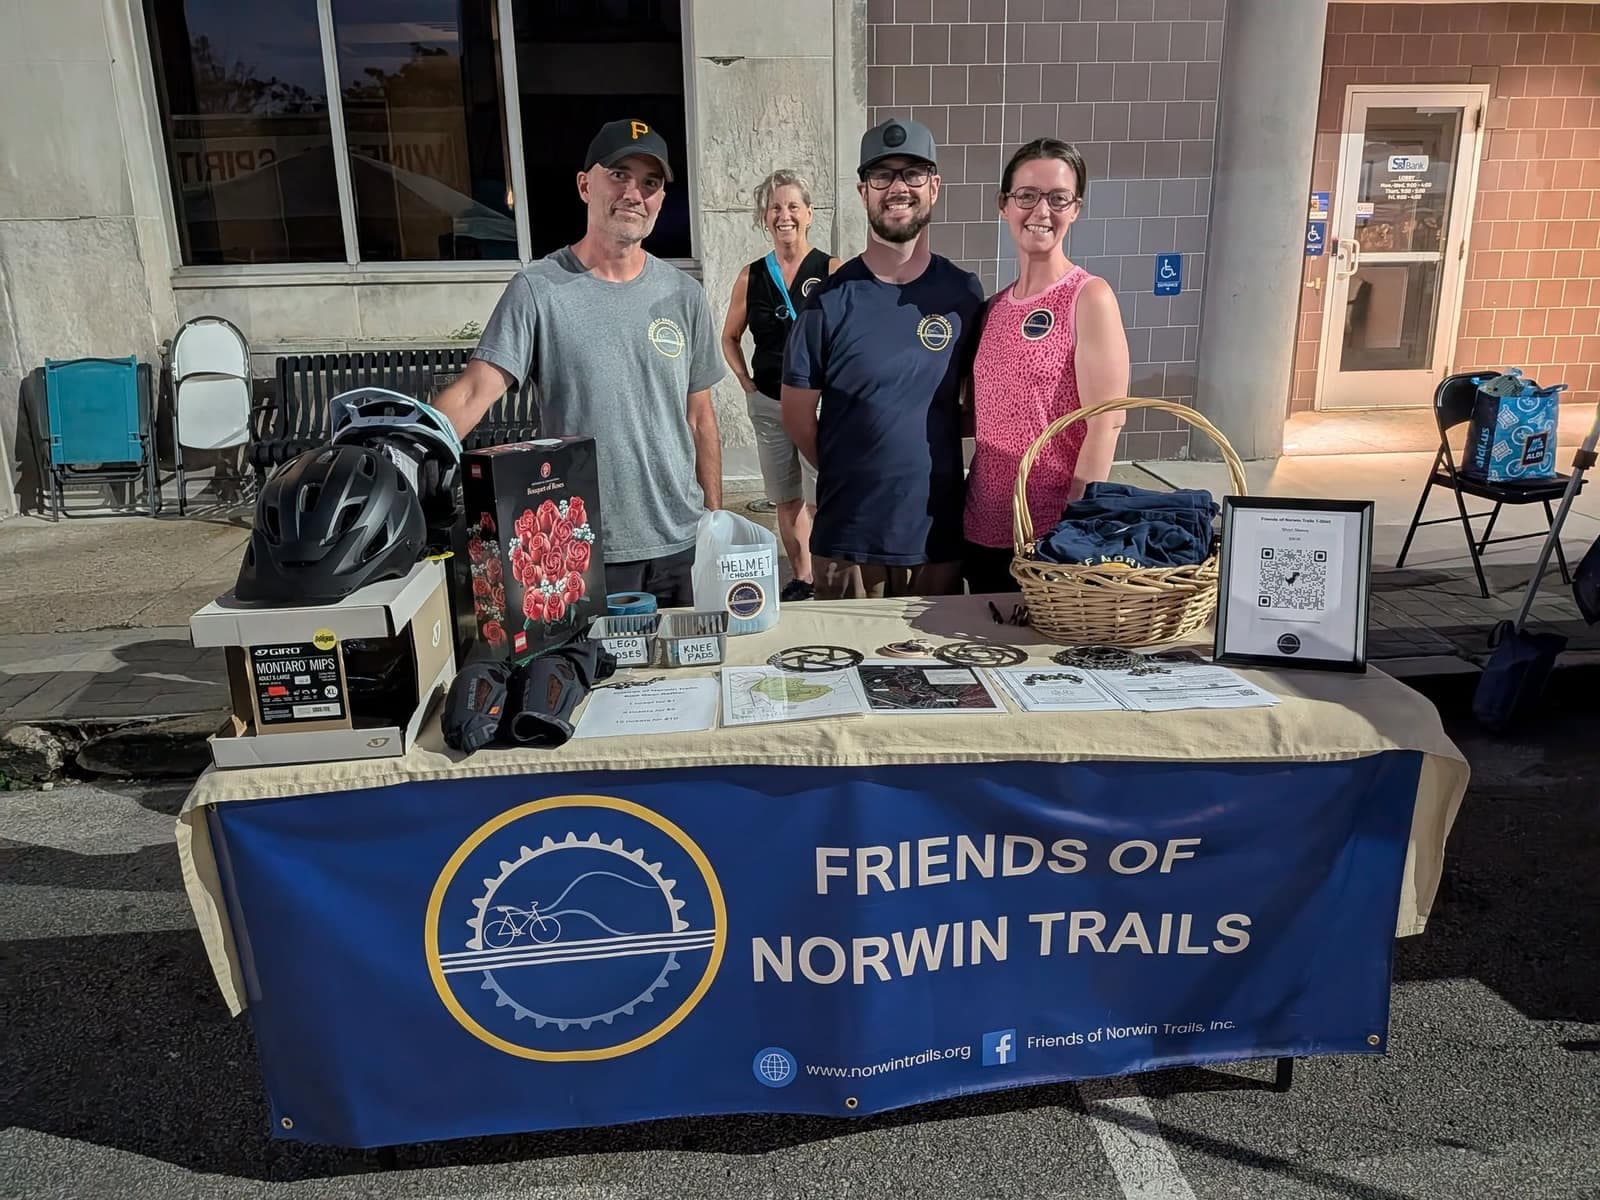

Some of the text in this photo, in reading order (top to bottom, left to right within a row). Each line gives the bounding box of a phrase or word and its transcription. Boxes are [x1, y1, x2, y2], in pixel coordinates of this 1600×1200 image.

[630, 121, 648, 139] P
[1406, 161, 1425, 170] Bank
[1475, 427, 1490, 467] aldi.us
[1526, 450, 1544, 460] ALDI
[722, 556, 770, 573] HELMET
[729, 570, 759, 579] CHOOSE
[269, 647, 300, 656] GIRO
[609, 639, 638, 650] LEGO
[683, 642, 712, 654] KNEE
[616, 650, 642, 659] OSES
[687, 651, 714, 662] PADS
[256, 658, 335, 674] MONTARO MIPS
[815, 834, 1202, 895] FRIENDS OF
[752, 910, 1253, 985] NORWIN TRAILS
[1027, 1018, 1237, 1050] Friends of Norwin Trails, Inc.
[806, 1041, 971, 1079] www.norwintrails.org
